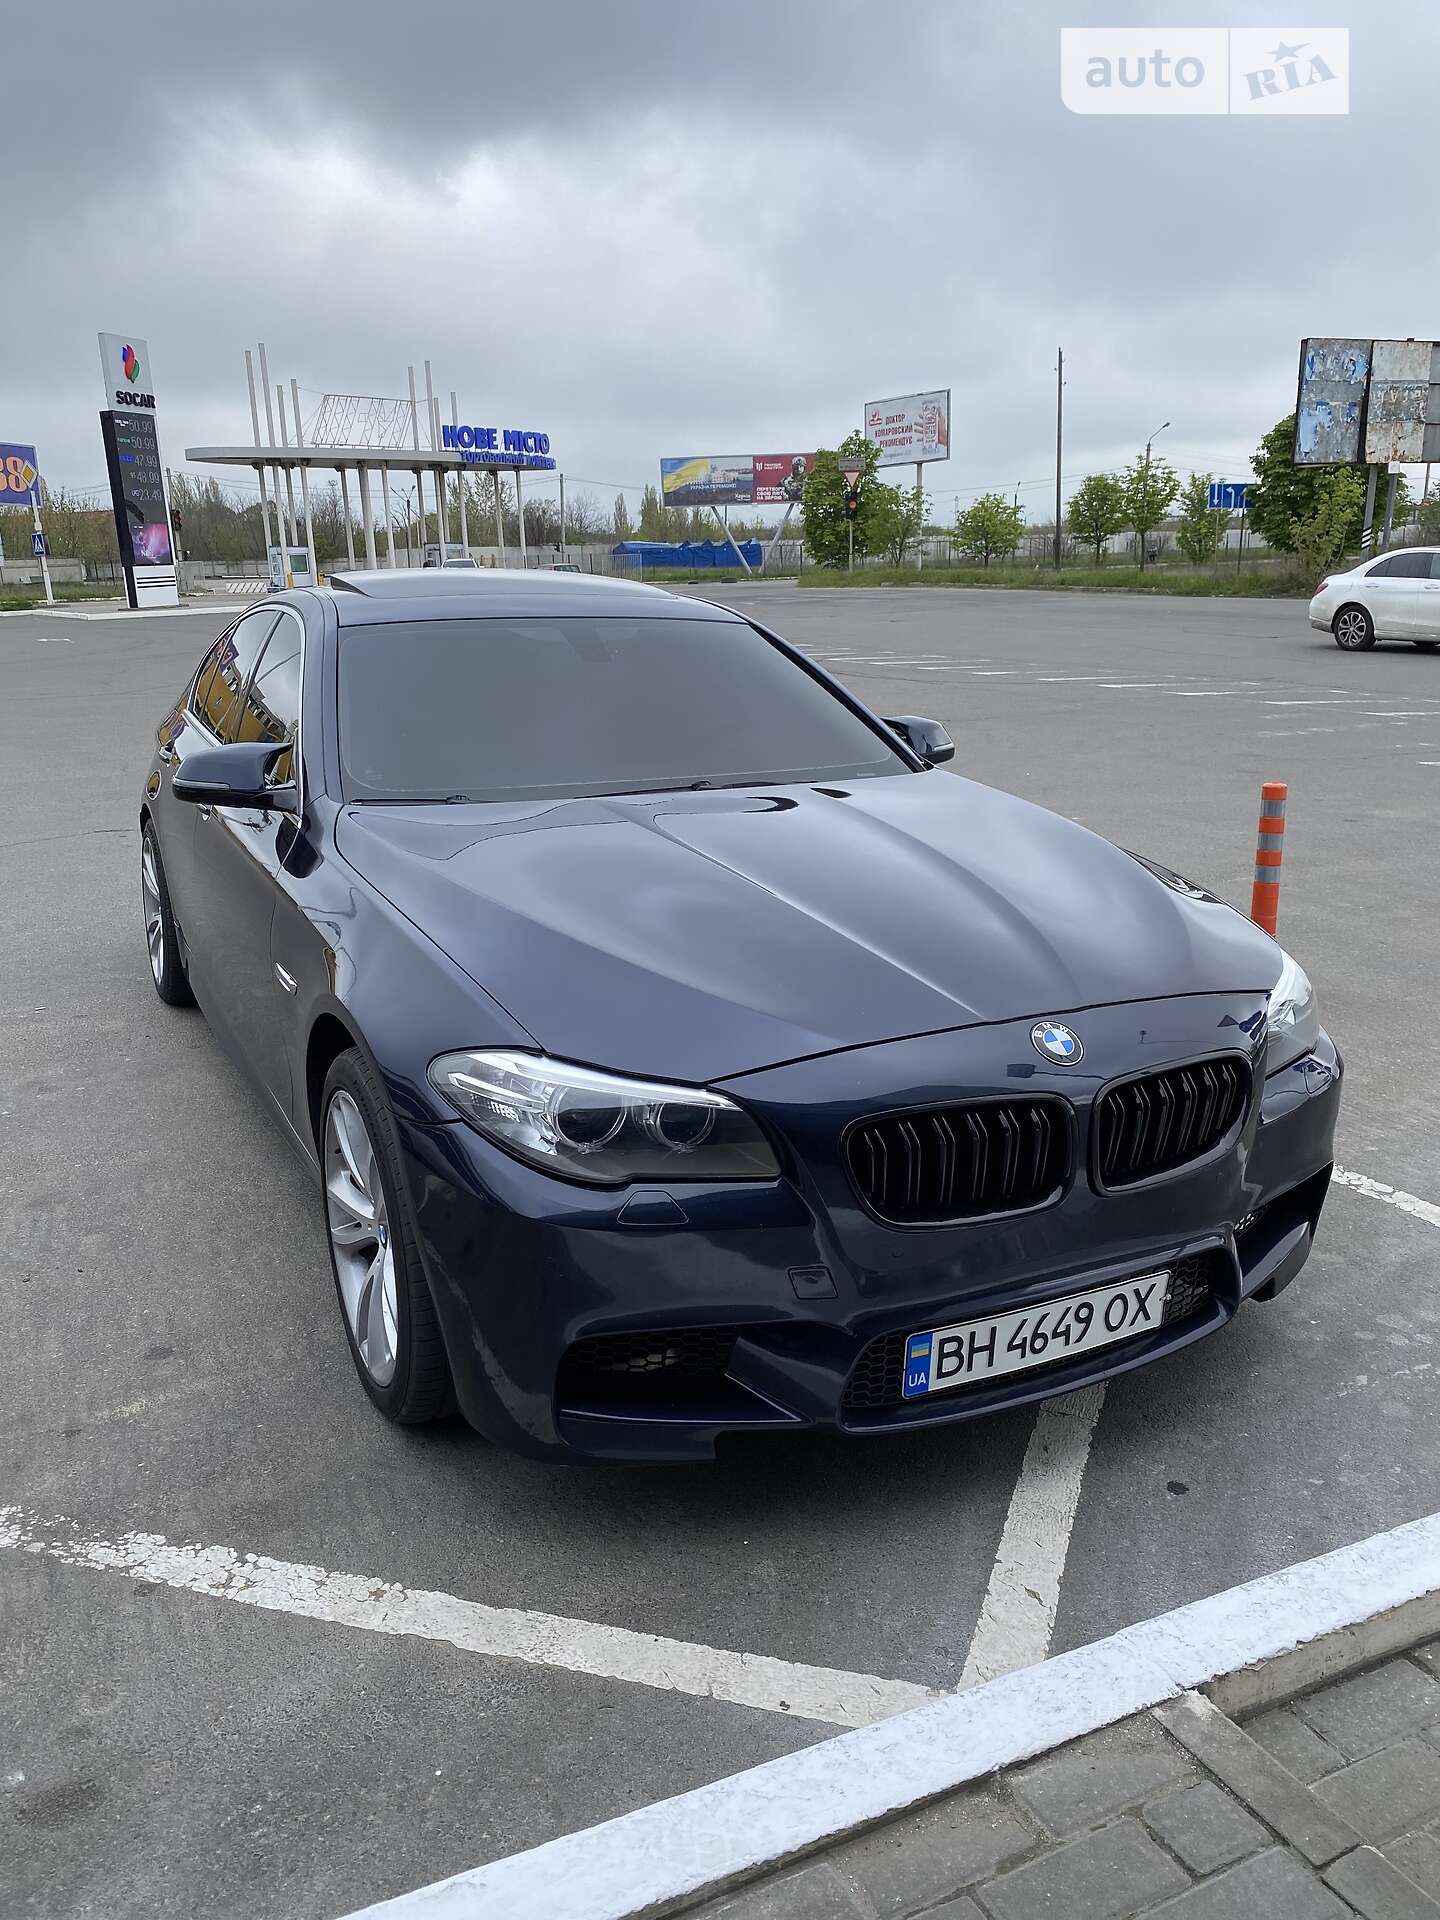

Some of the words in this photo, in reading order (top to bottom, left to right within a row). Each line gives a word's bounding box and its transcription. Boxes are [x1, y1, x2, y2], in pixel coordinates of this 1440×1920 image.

[116, 390, 156, 409] SOCAR
[885, 413, 906, 425] ДОКТОР
[442, 425, 498, 450] НОВЕ
[503, 429, 550, 455] МІСТО
[936, 1326, 998, 1380] BH
[1006, 1301, 1094, 1360] 4649
[1104, 1283, 1157, 1333] OX
[908, 1372, 927, 1388] UA
